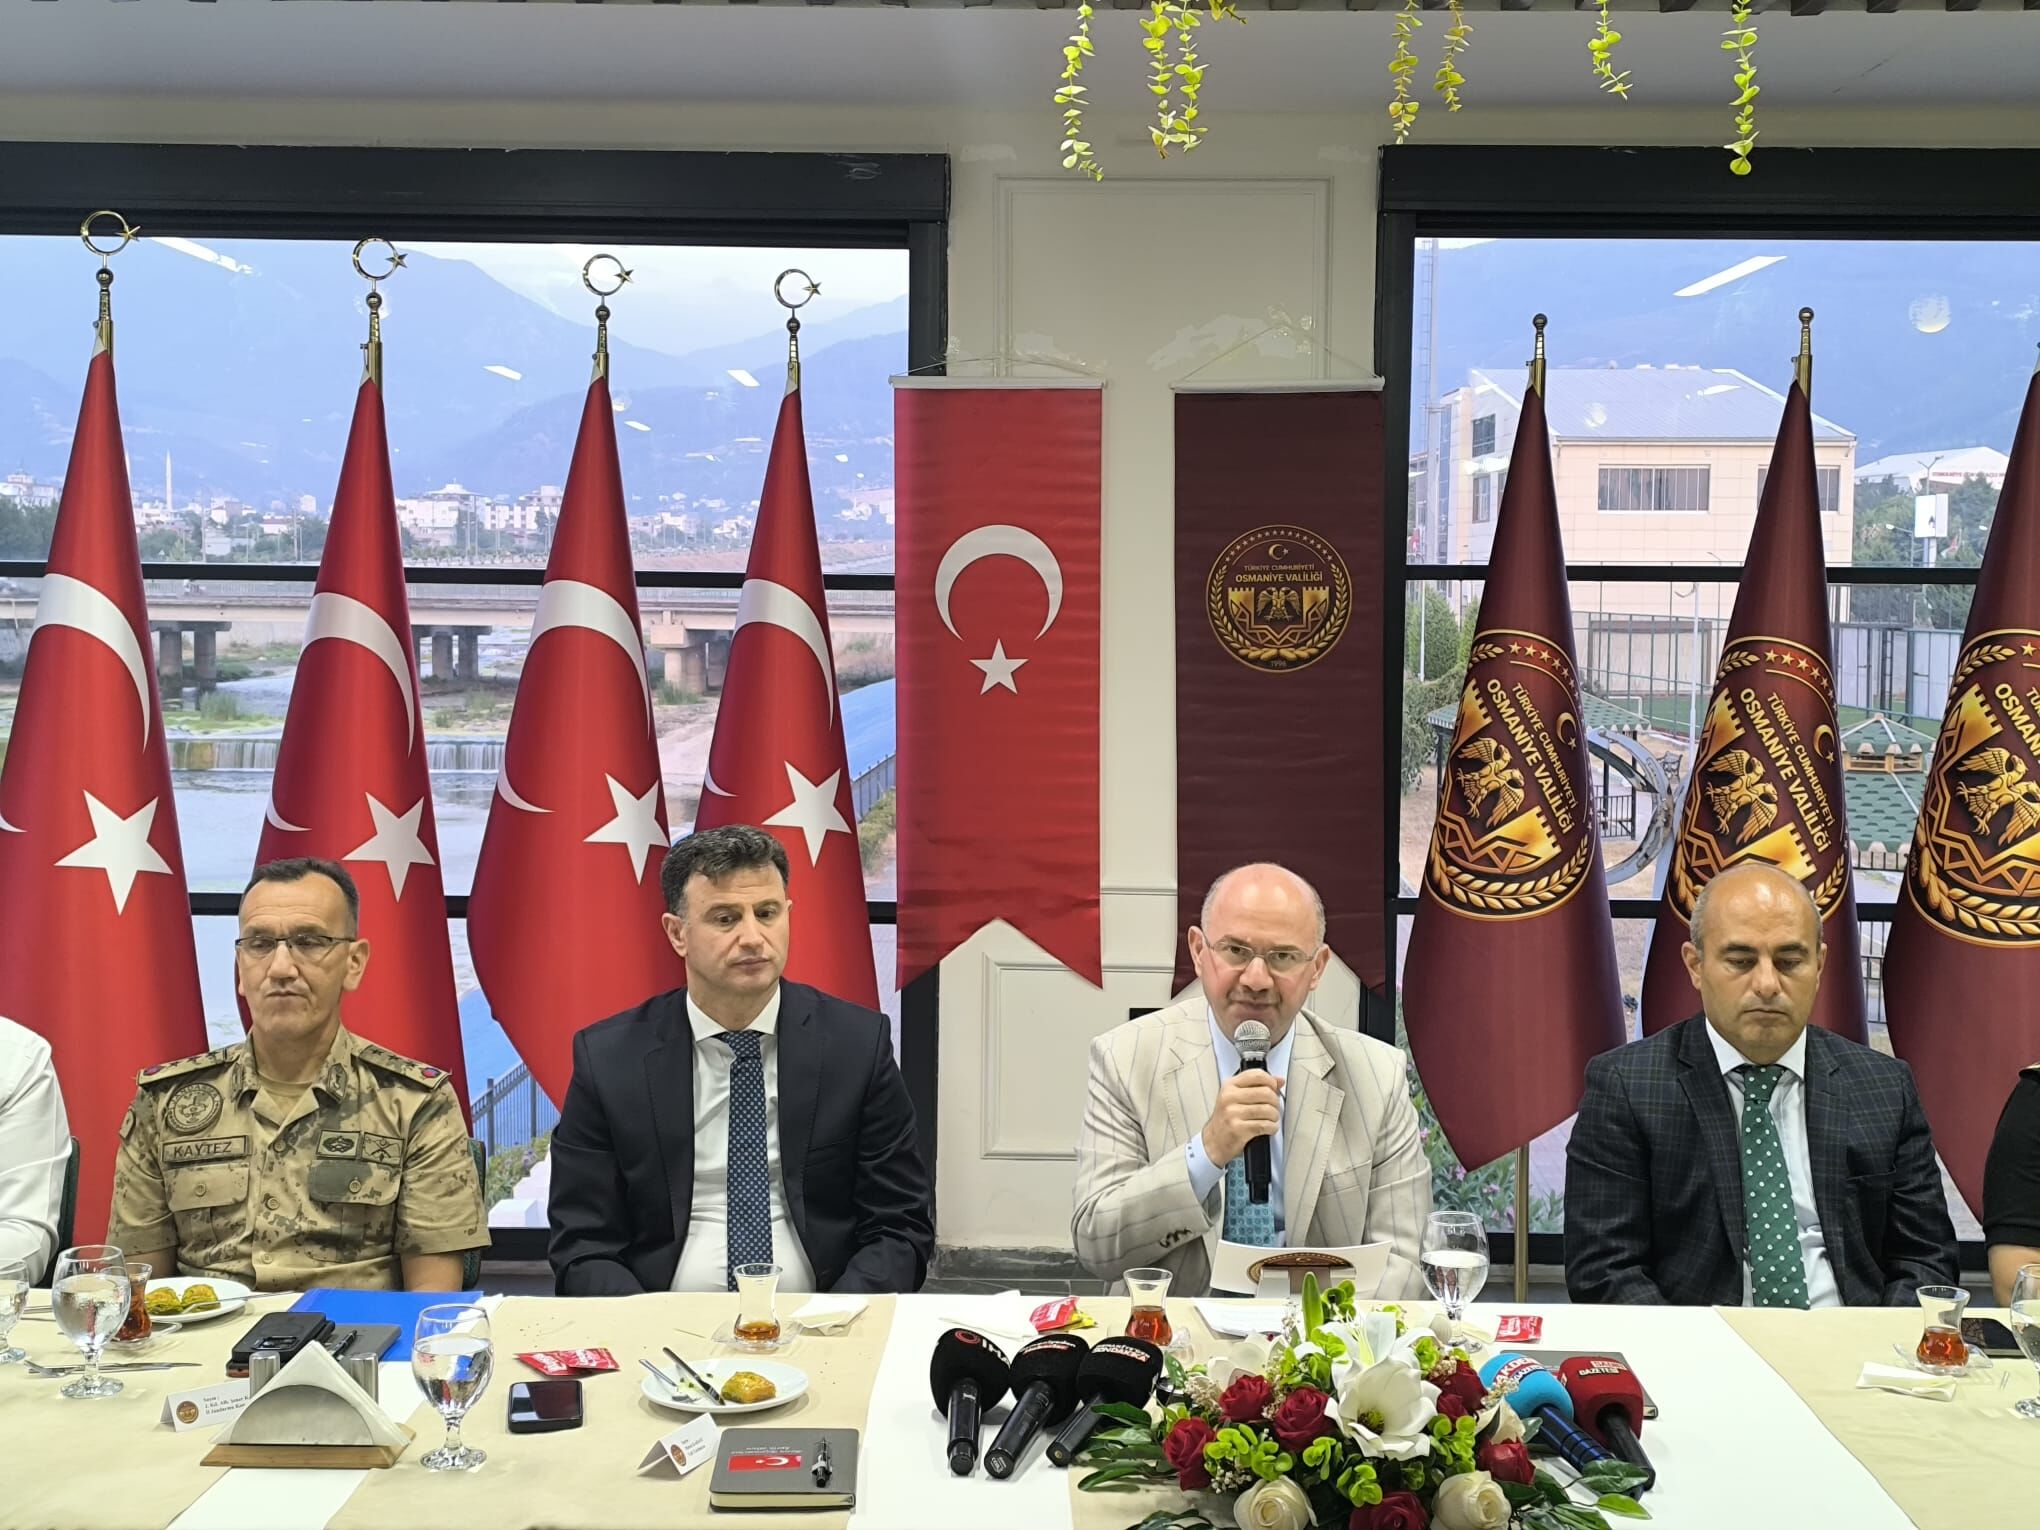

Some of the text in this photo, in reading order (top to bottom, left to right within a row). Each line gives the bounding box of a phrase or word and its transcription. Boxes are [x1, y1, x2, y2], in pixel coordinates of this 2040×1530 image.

[1235, 570, 1323, 582] OSMANİYE VALİLİĞİ
[1244, 563, 1270, 571] TÜRKİYE
[1487, 678, 1575, 836] OSMANİYE VALİLİĞİ
[1511, 682, 1578, 810] TÜRKİYE CUMHURİYETİ
[1740, 687, 1832, 854] OSMANİYE VALİLİĞİ
[1767, 691, 1837, 829] TÜRKİYE CUMHURİYETİ
[1995, 683, 2040, 764] OSMAN
[173, 1140, 233, 1158] KAYTEZ
